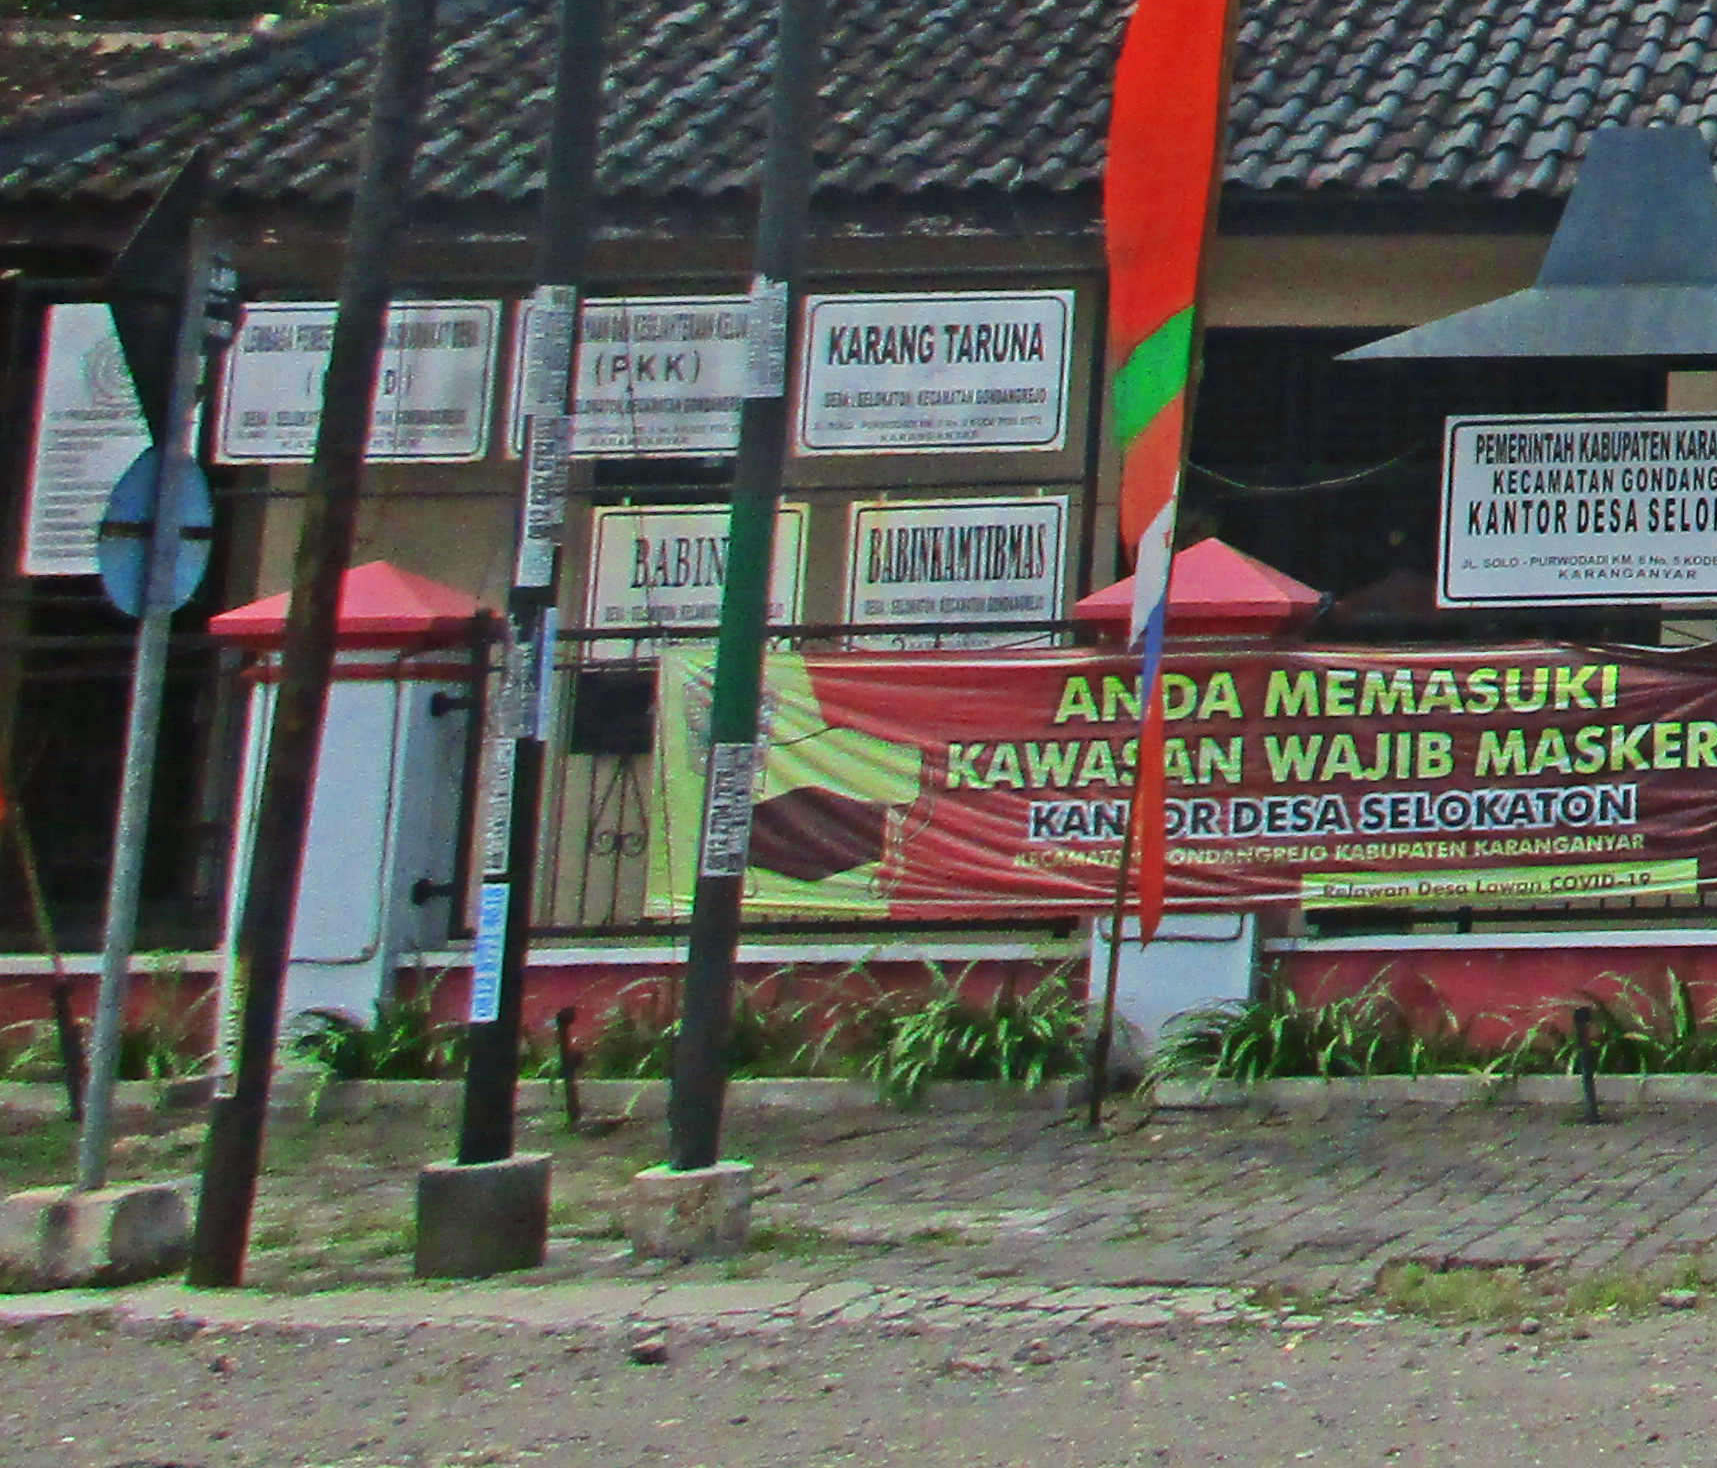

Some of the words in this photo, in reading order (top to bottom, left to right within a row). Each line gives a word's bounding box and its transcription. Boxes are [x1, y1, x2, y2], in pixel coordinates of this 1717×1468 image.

[827, 324, 936, 366] KARANG
[944, 322, 1045, 363] TARUNA
[1476, 433, 1575, 464] PEMERINTAH
[1579, 431, 1671, 463] KABUPATEN
[1493, 468, 1613, 495] KECAMATAN
[1468, 499, 1567, 535] KANTOR
[1577, 498, 1638, 533] DESA
[1558, 568, 1698, 579] KARANGANYAR
[1055, 671, 1243, 724] ANDA
[1264, 664, 1619, 718] MEMASUKI
[1264, 730, 1454, 784] WAJIB
[1029, 800, 1221, 841] KANOR
[1229, 794, 1352, 836] DESA
[1359, 782, 1638, 834] SELOKATON
[1166, 843, 1327, 865] ONDANGREJO
[1336, 840, 1467, 861] KABUPATEN
[1474, 834, 1645, 857] KARANGANYAR
[1323, 883, 1410, 899] Relawan
[1418, 881, 1469, 896] Desa
[1476, 878, 1543, 894] Lawan
